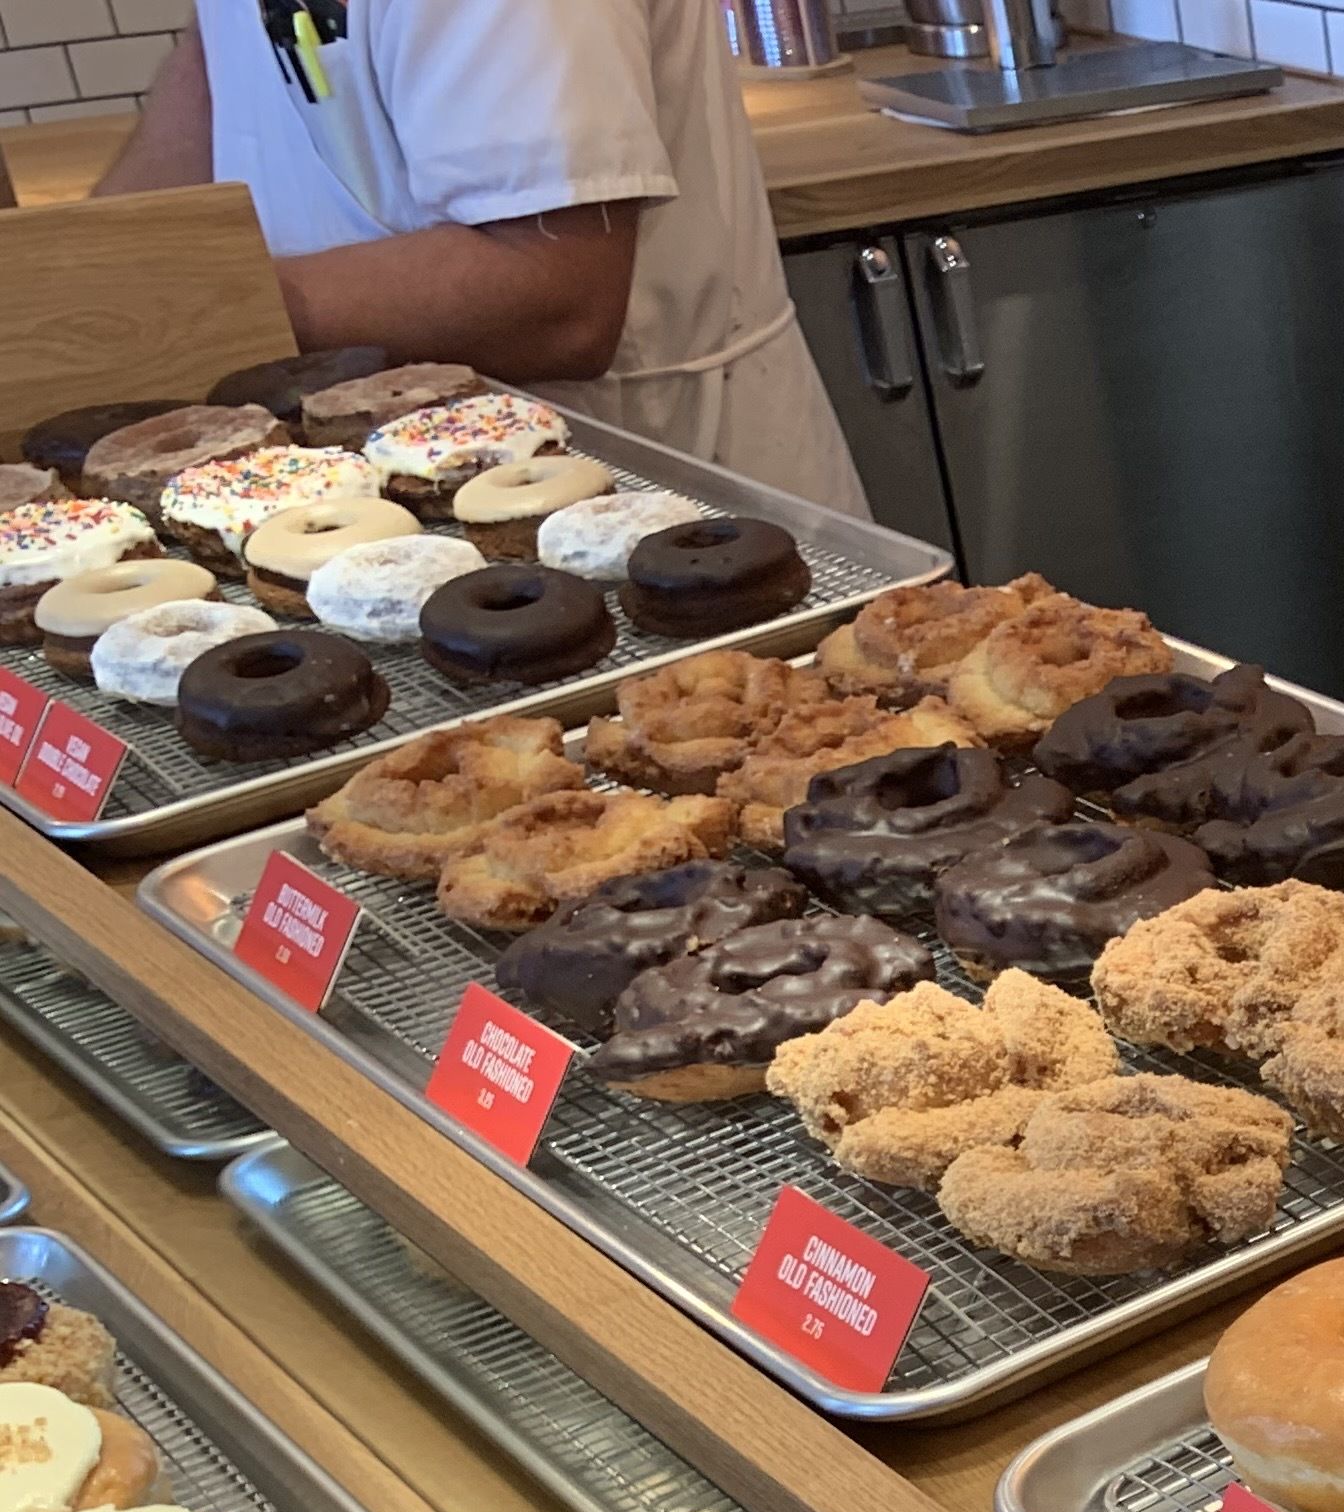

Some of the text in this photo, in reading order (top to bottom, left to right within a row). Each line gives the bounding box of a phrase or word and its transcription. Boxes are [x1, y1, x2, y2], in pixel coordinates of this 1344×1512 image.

[462, 1039, 534, 1104] OLD FASHIONED
[480, 1020, 536, 1074] CHOCOLATE
[777, 1254, 877, 1336] OLD FASHIONED
[803, 1235, 876, 1300] CINNAMON
[802, 1313, 825, 1340] 2.75
